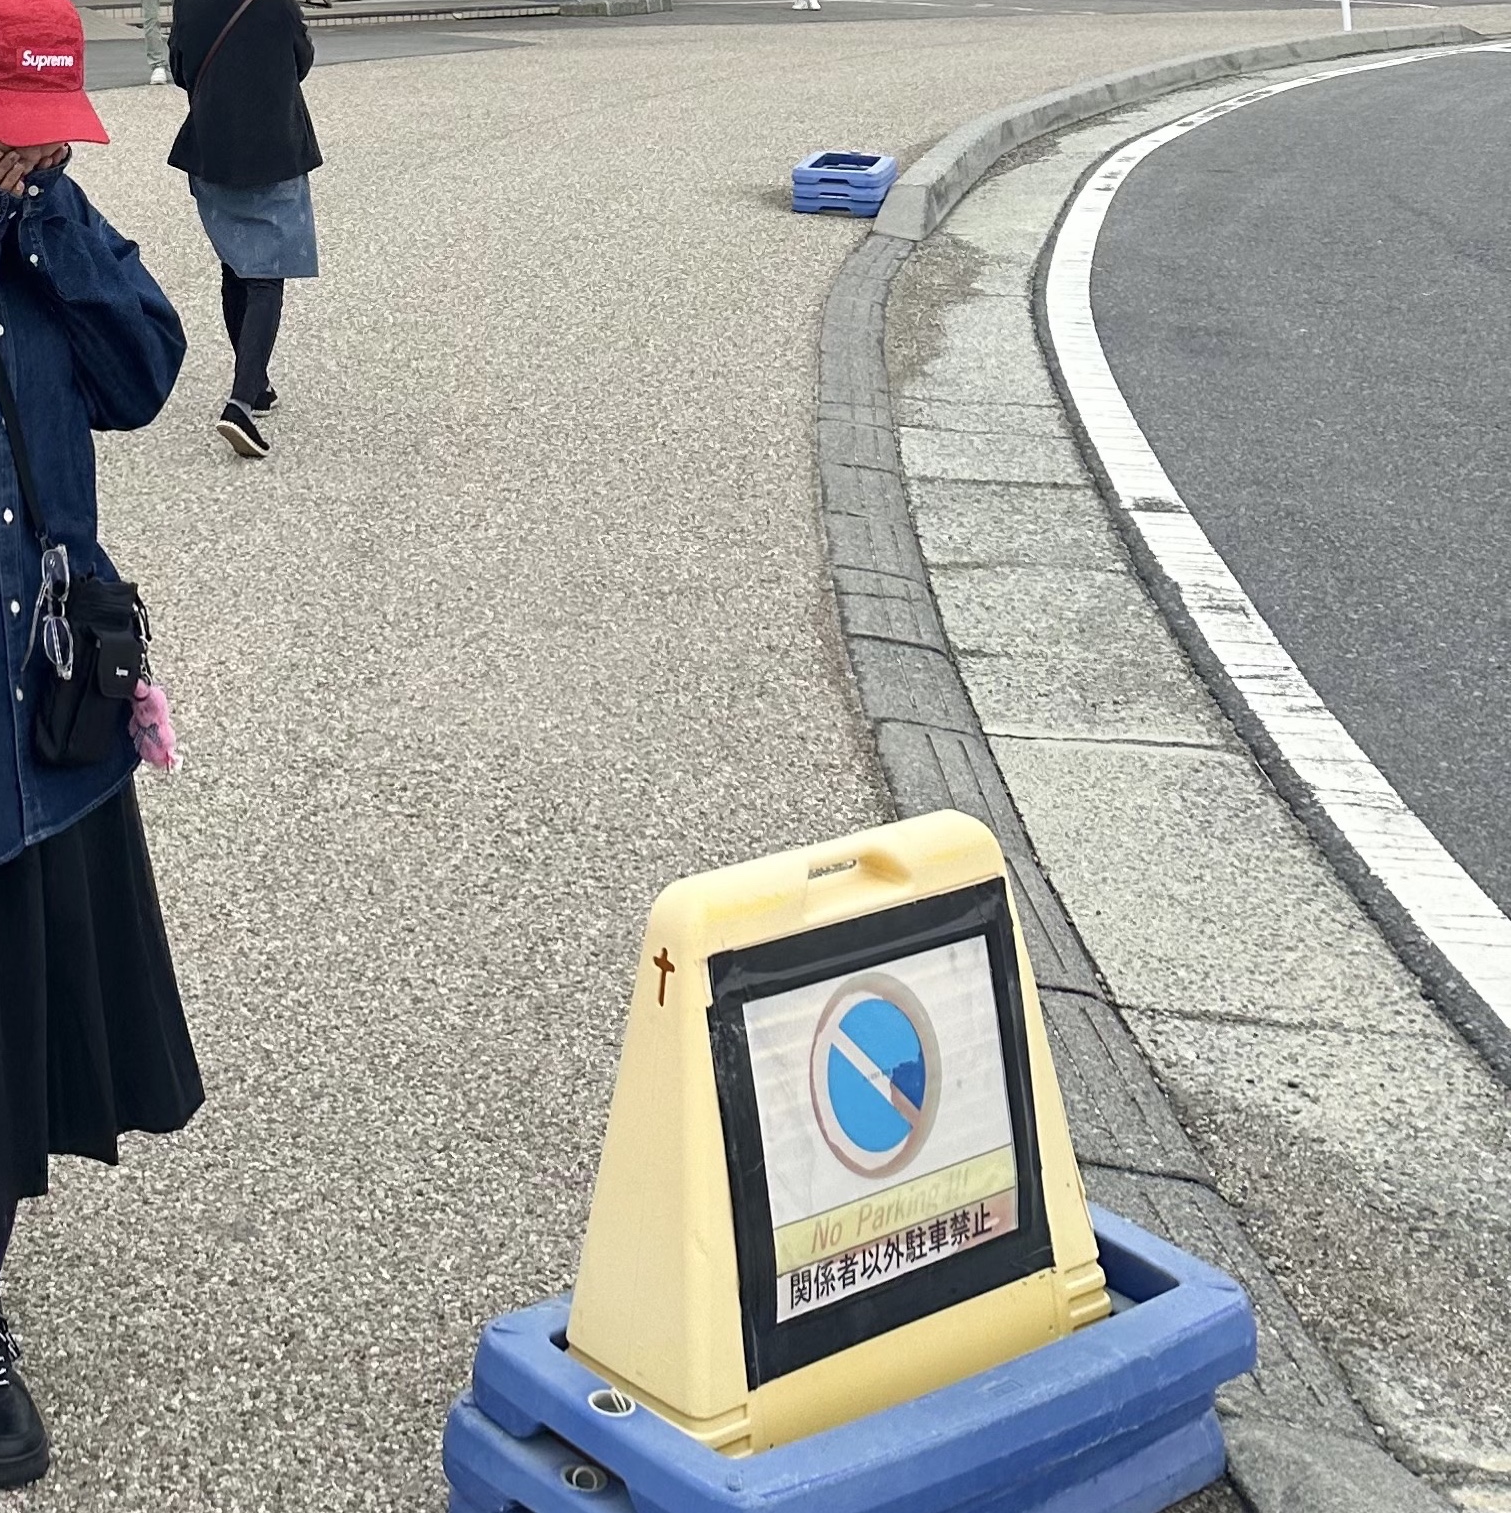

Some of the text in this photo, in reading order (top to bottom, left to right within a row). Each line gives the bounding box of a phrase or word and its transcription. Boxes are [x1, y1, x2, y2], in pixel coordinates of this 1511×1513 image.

[21, 49, 74, 71] Supreme
[811, 1219, 843, 1255] No
[790, 1202, 993, 1311] 関係者以外駐車禁止
